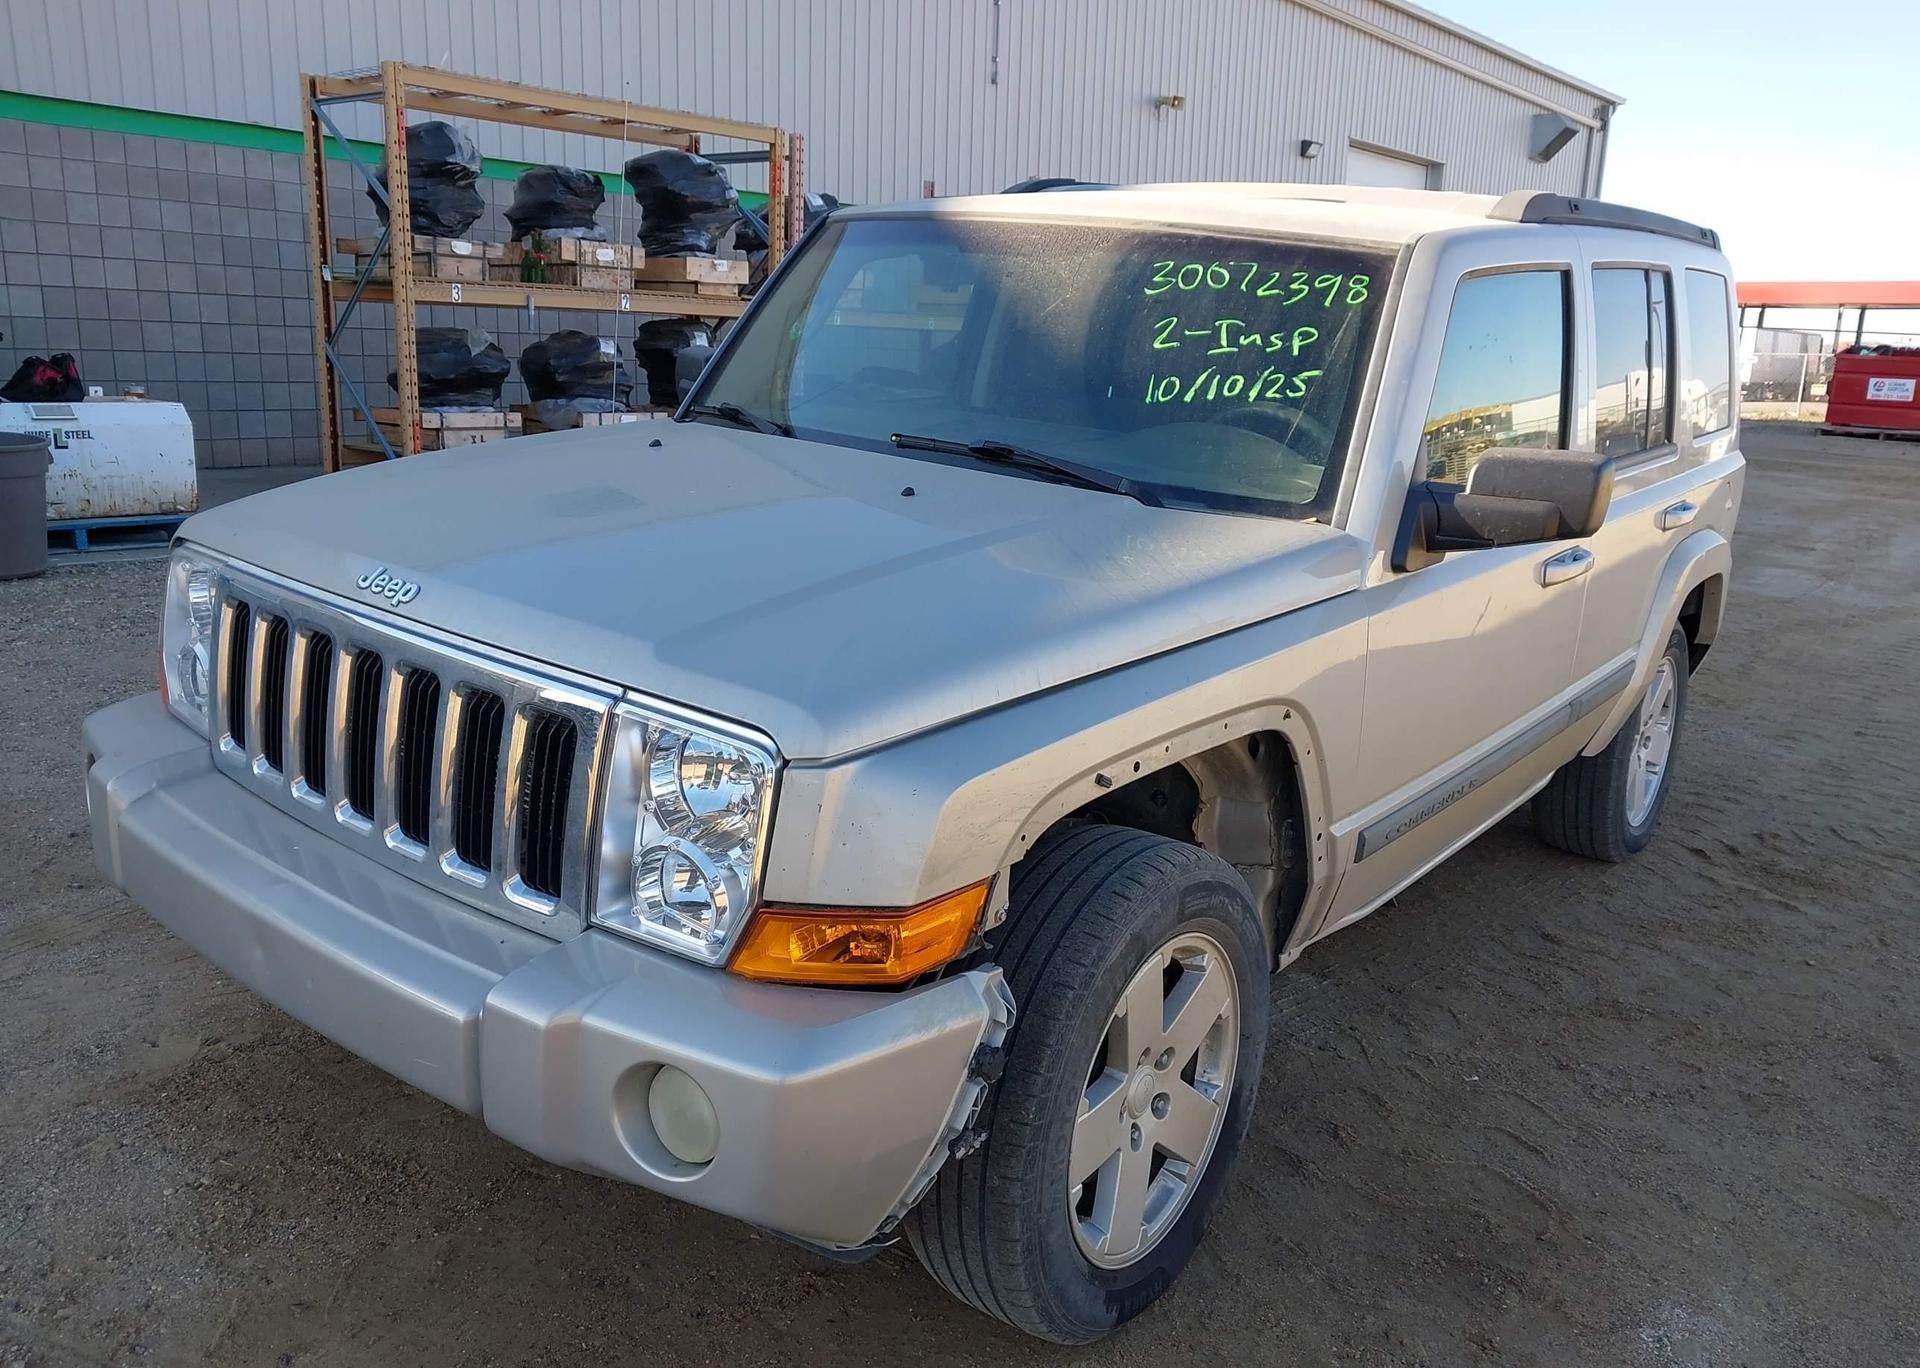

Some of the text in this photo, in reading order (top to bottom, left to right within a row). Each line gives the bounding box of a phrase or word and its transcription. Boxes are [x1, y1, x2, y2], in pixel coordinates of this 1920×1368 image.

[1146, 366, 1323, 403] 10/10/25
[64, 430, 92, 440] STEEL
[356, 566, 421, 607] Jeep
